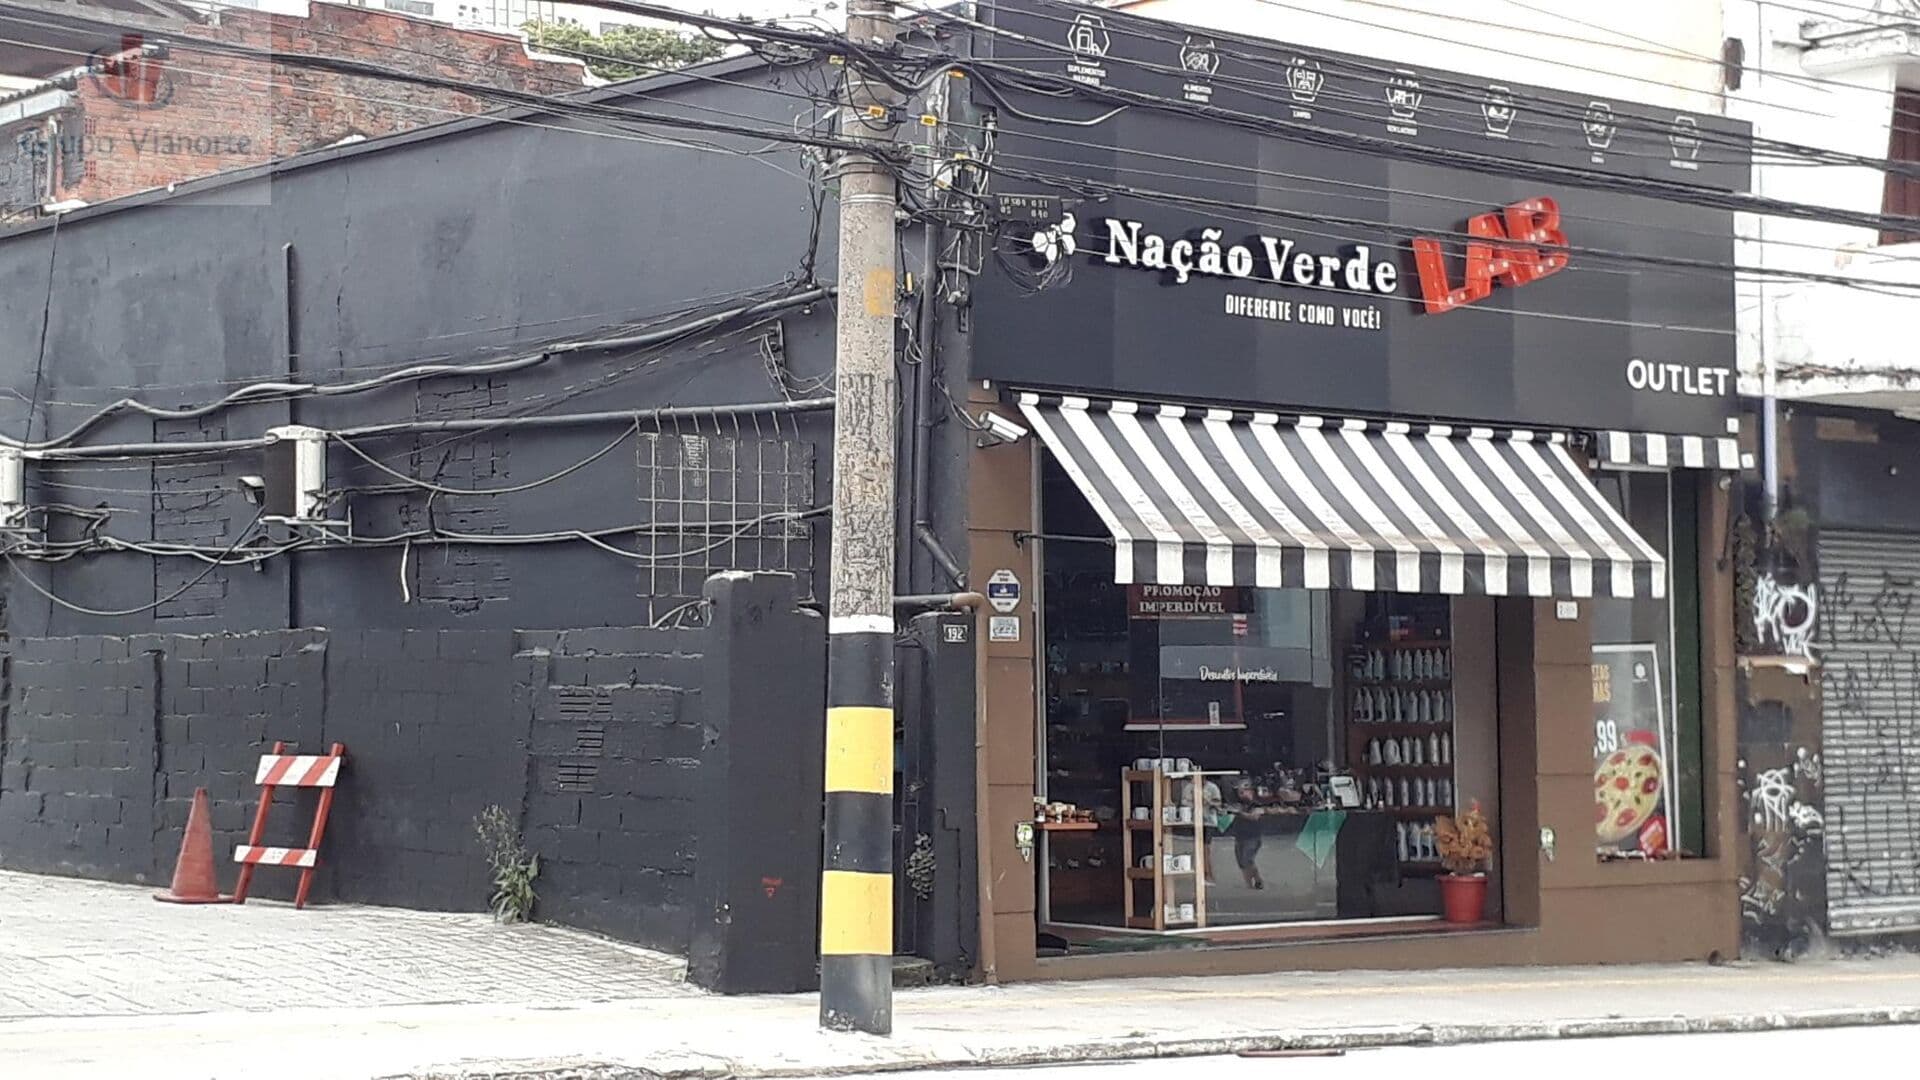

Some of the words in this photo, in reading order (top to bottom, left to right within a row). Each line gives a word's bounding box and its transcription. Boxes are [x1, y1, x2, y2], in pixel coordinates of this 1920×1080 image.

[1104, 218, 1253, 283] Nação
[1260, 235, 1398, 294] Verde
[1412, 196, 1569, 315] LAB
[1225, 294, 1292, 322] DIFERENTE
[1298, 303, 1335, 326] COMO
[1342, 305, 1382, 330] VOCÊ!
[1626, 359, 1730, 396] OUTLET
[1139, 601, 1225, 613] IMPERDÍVEL
[947, 627, 964, 640] 192
